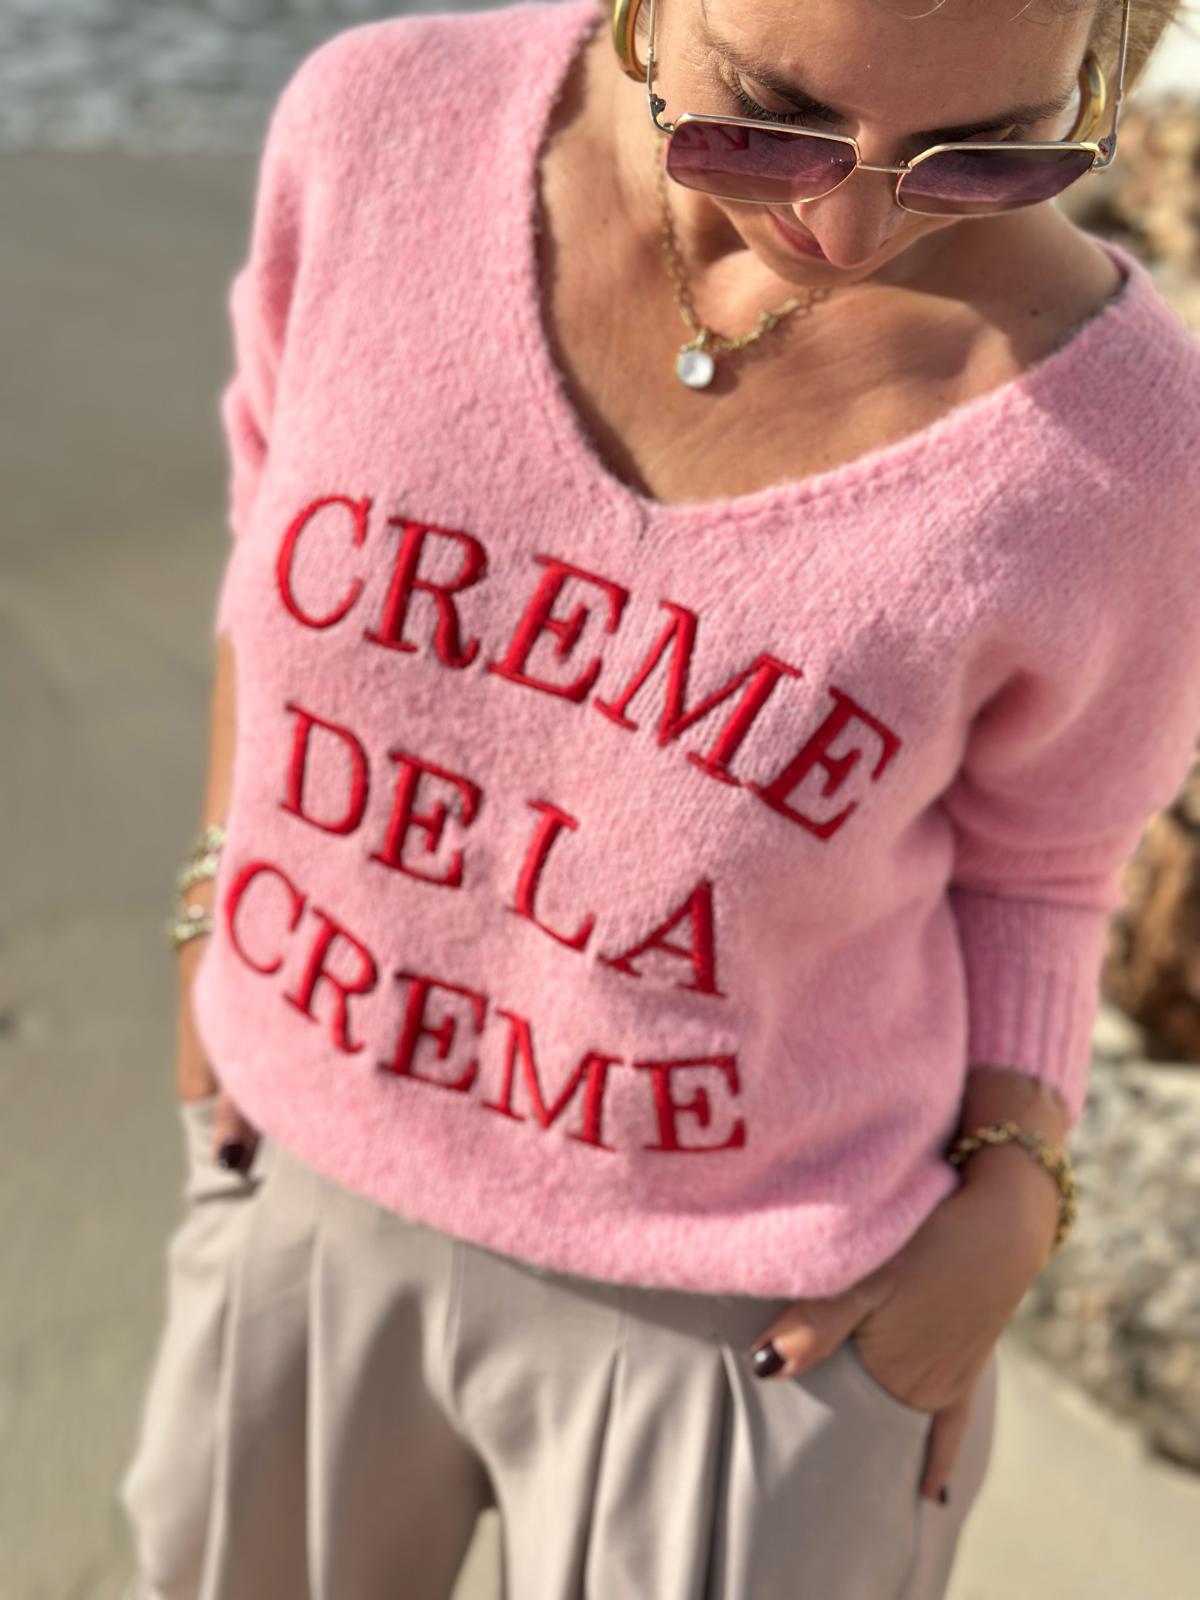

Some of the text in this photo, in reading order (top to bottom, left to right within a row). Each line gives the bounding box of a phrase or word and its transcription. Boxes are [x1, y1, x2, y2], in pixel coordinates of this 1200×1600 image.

[276, 494, 903, 841] CREME
[280, 702, 726, 999] DE LA
[223, 860, 748, 1154] CREME
